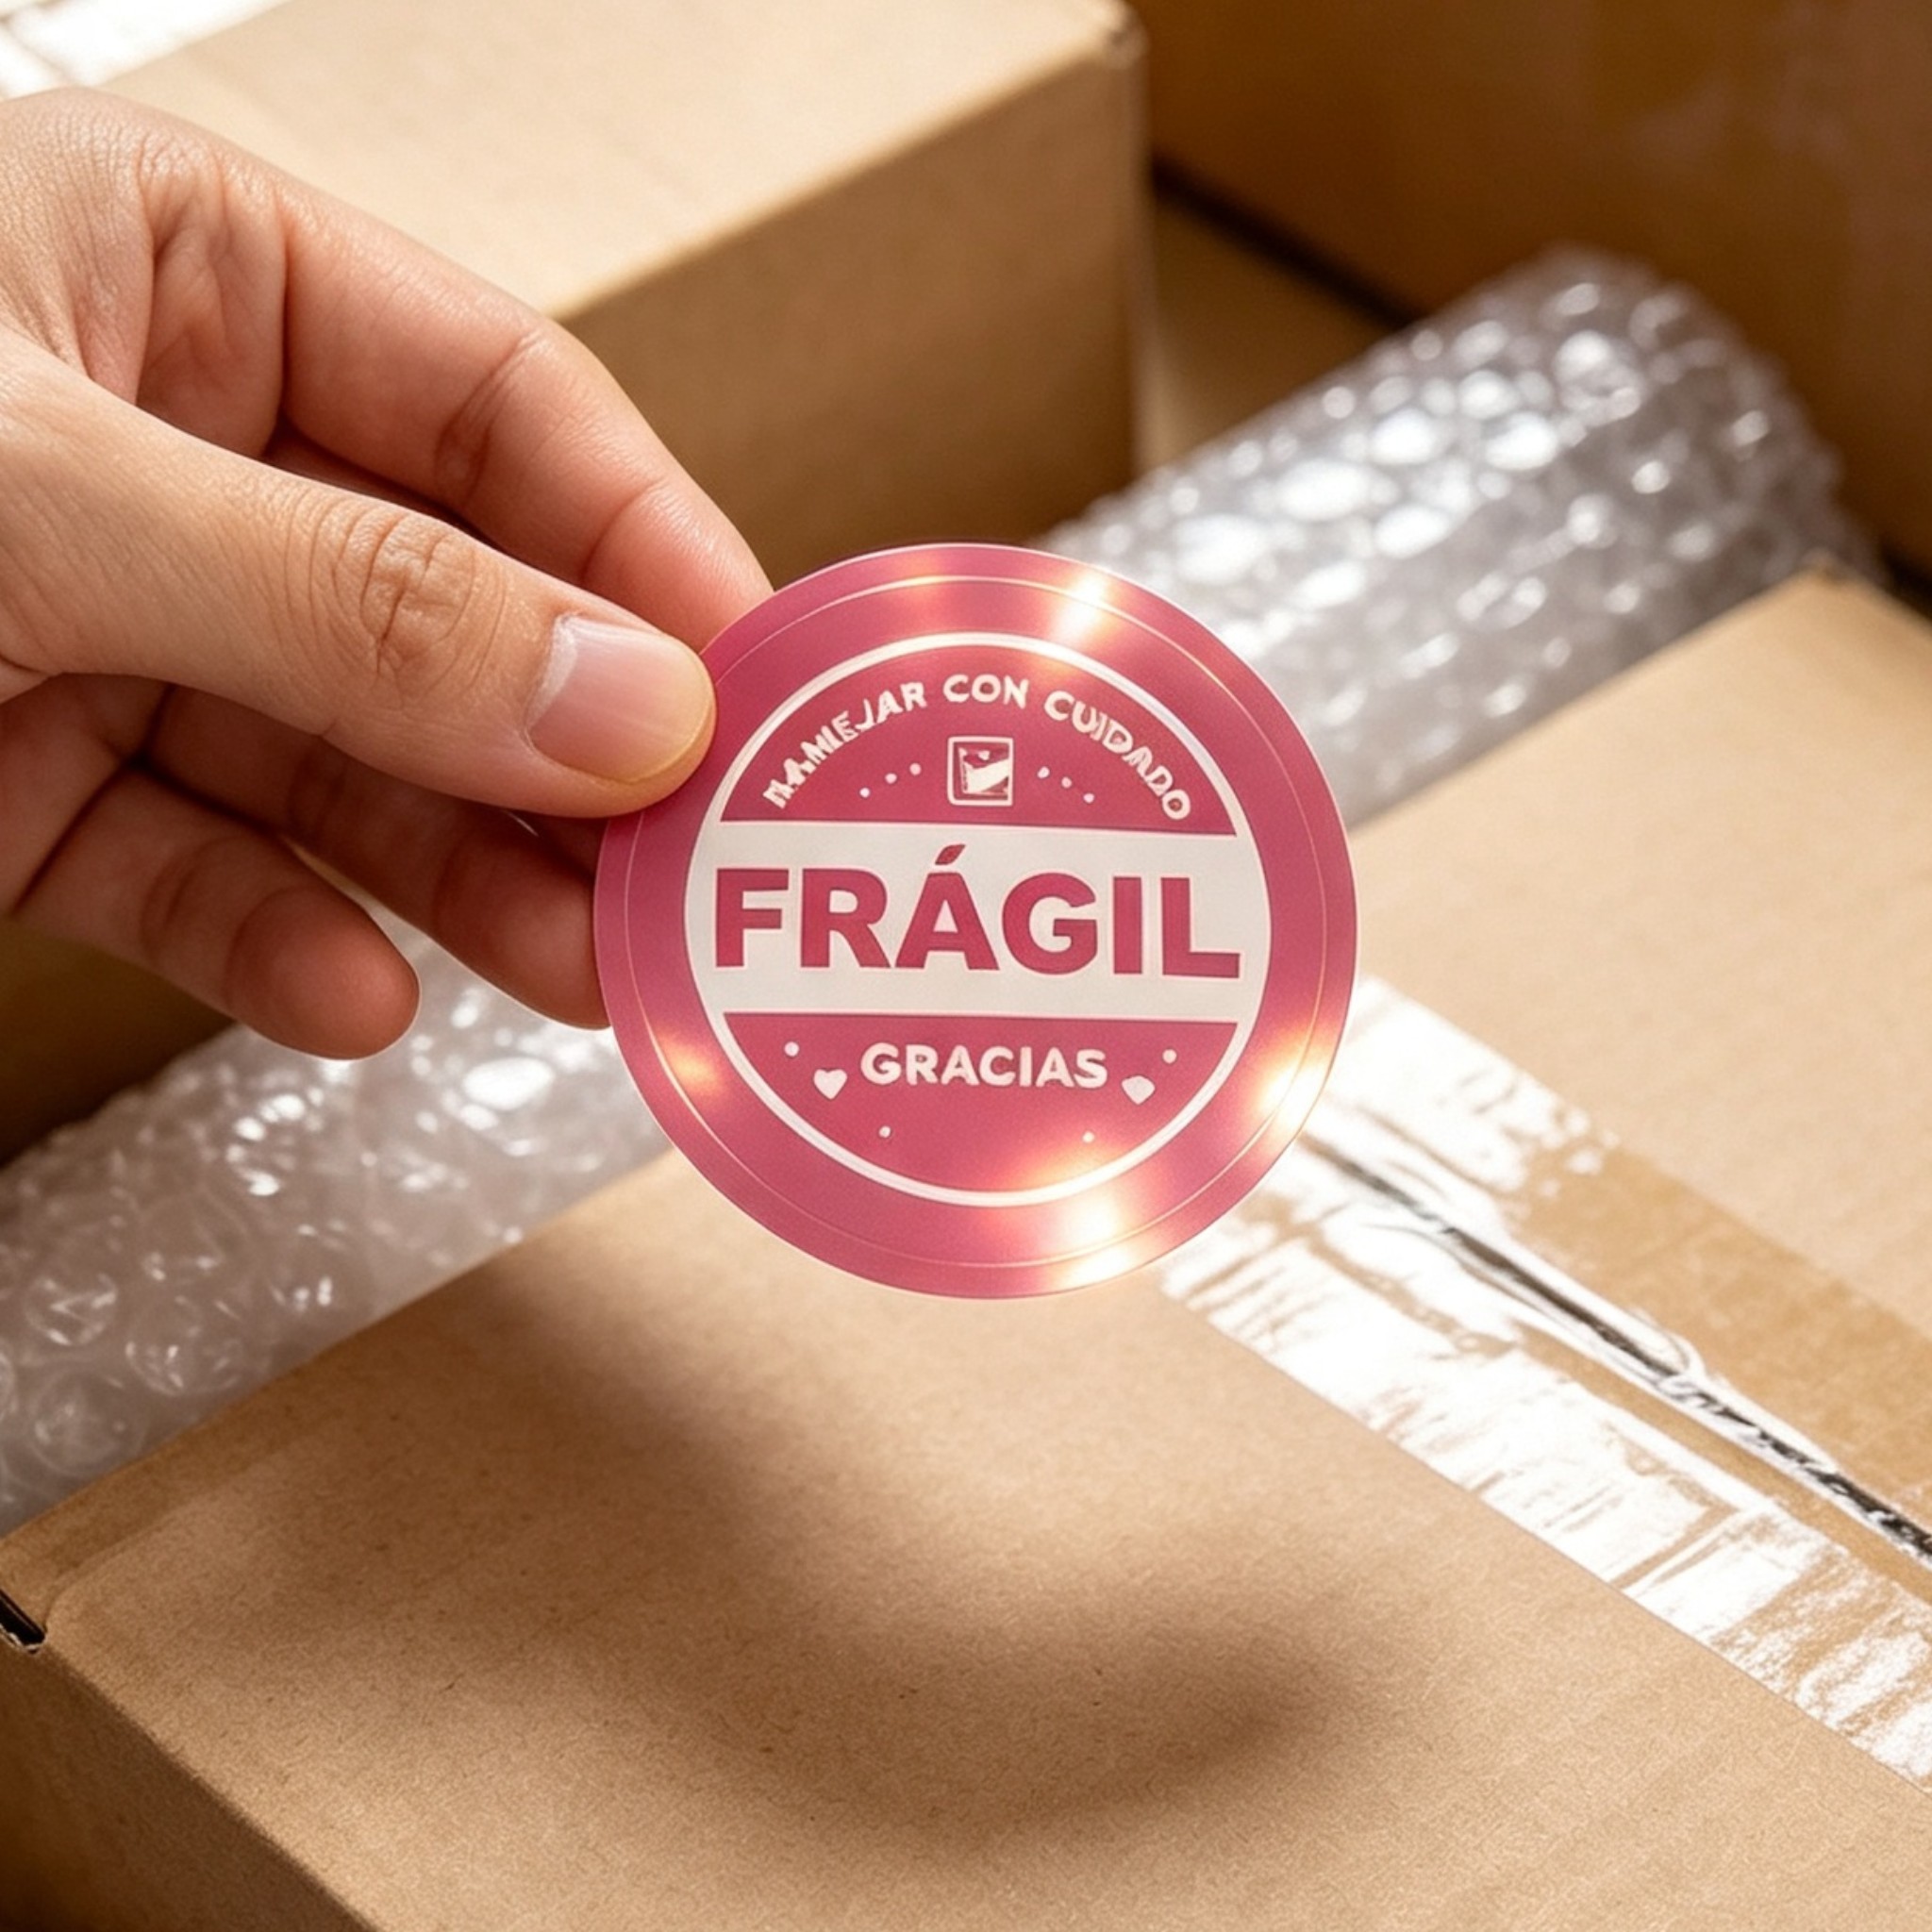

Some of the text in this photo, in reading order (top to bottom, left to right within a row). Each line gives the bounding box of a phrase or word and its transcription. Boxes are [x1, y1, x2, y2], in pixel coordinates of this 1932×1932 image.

[942, 674, 1029, 709] CON
[715, 843, 1241, 979] FRÁGIL
[860, 1042, 1108, 1089] GRACIAS
